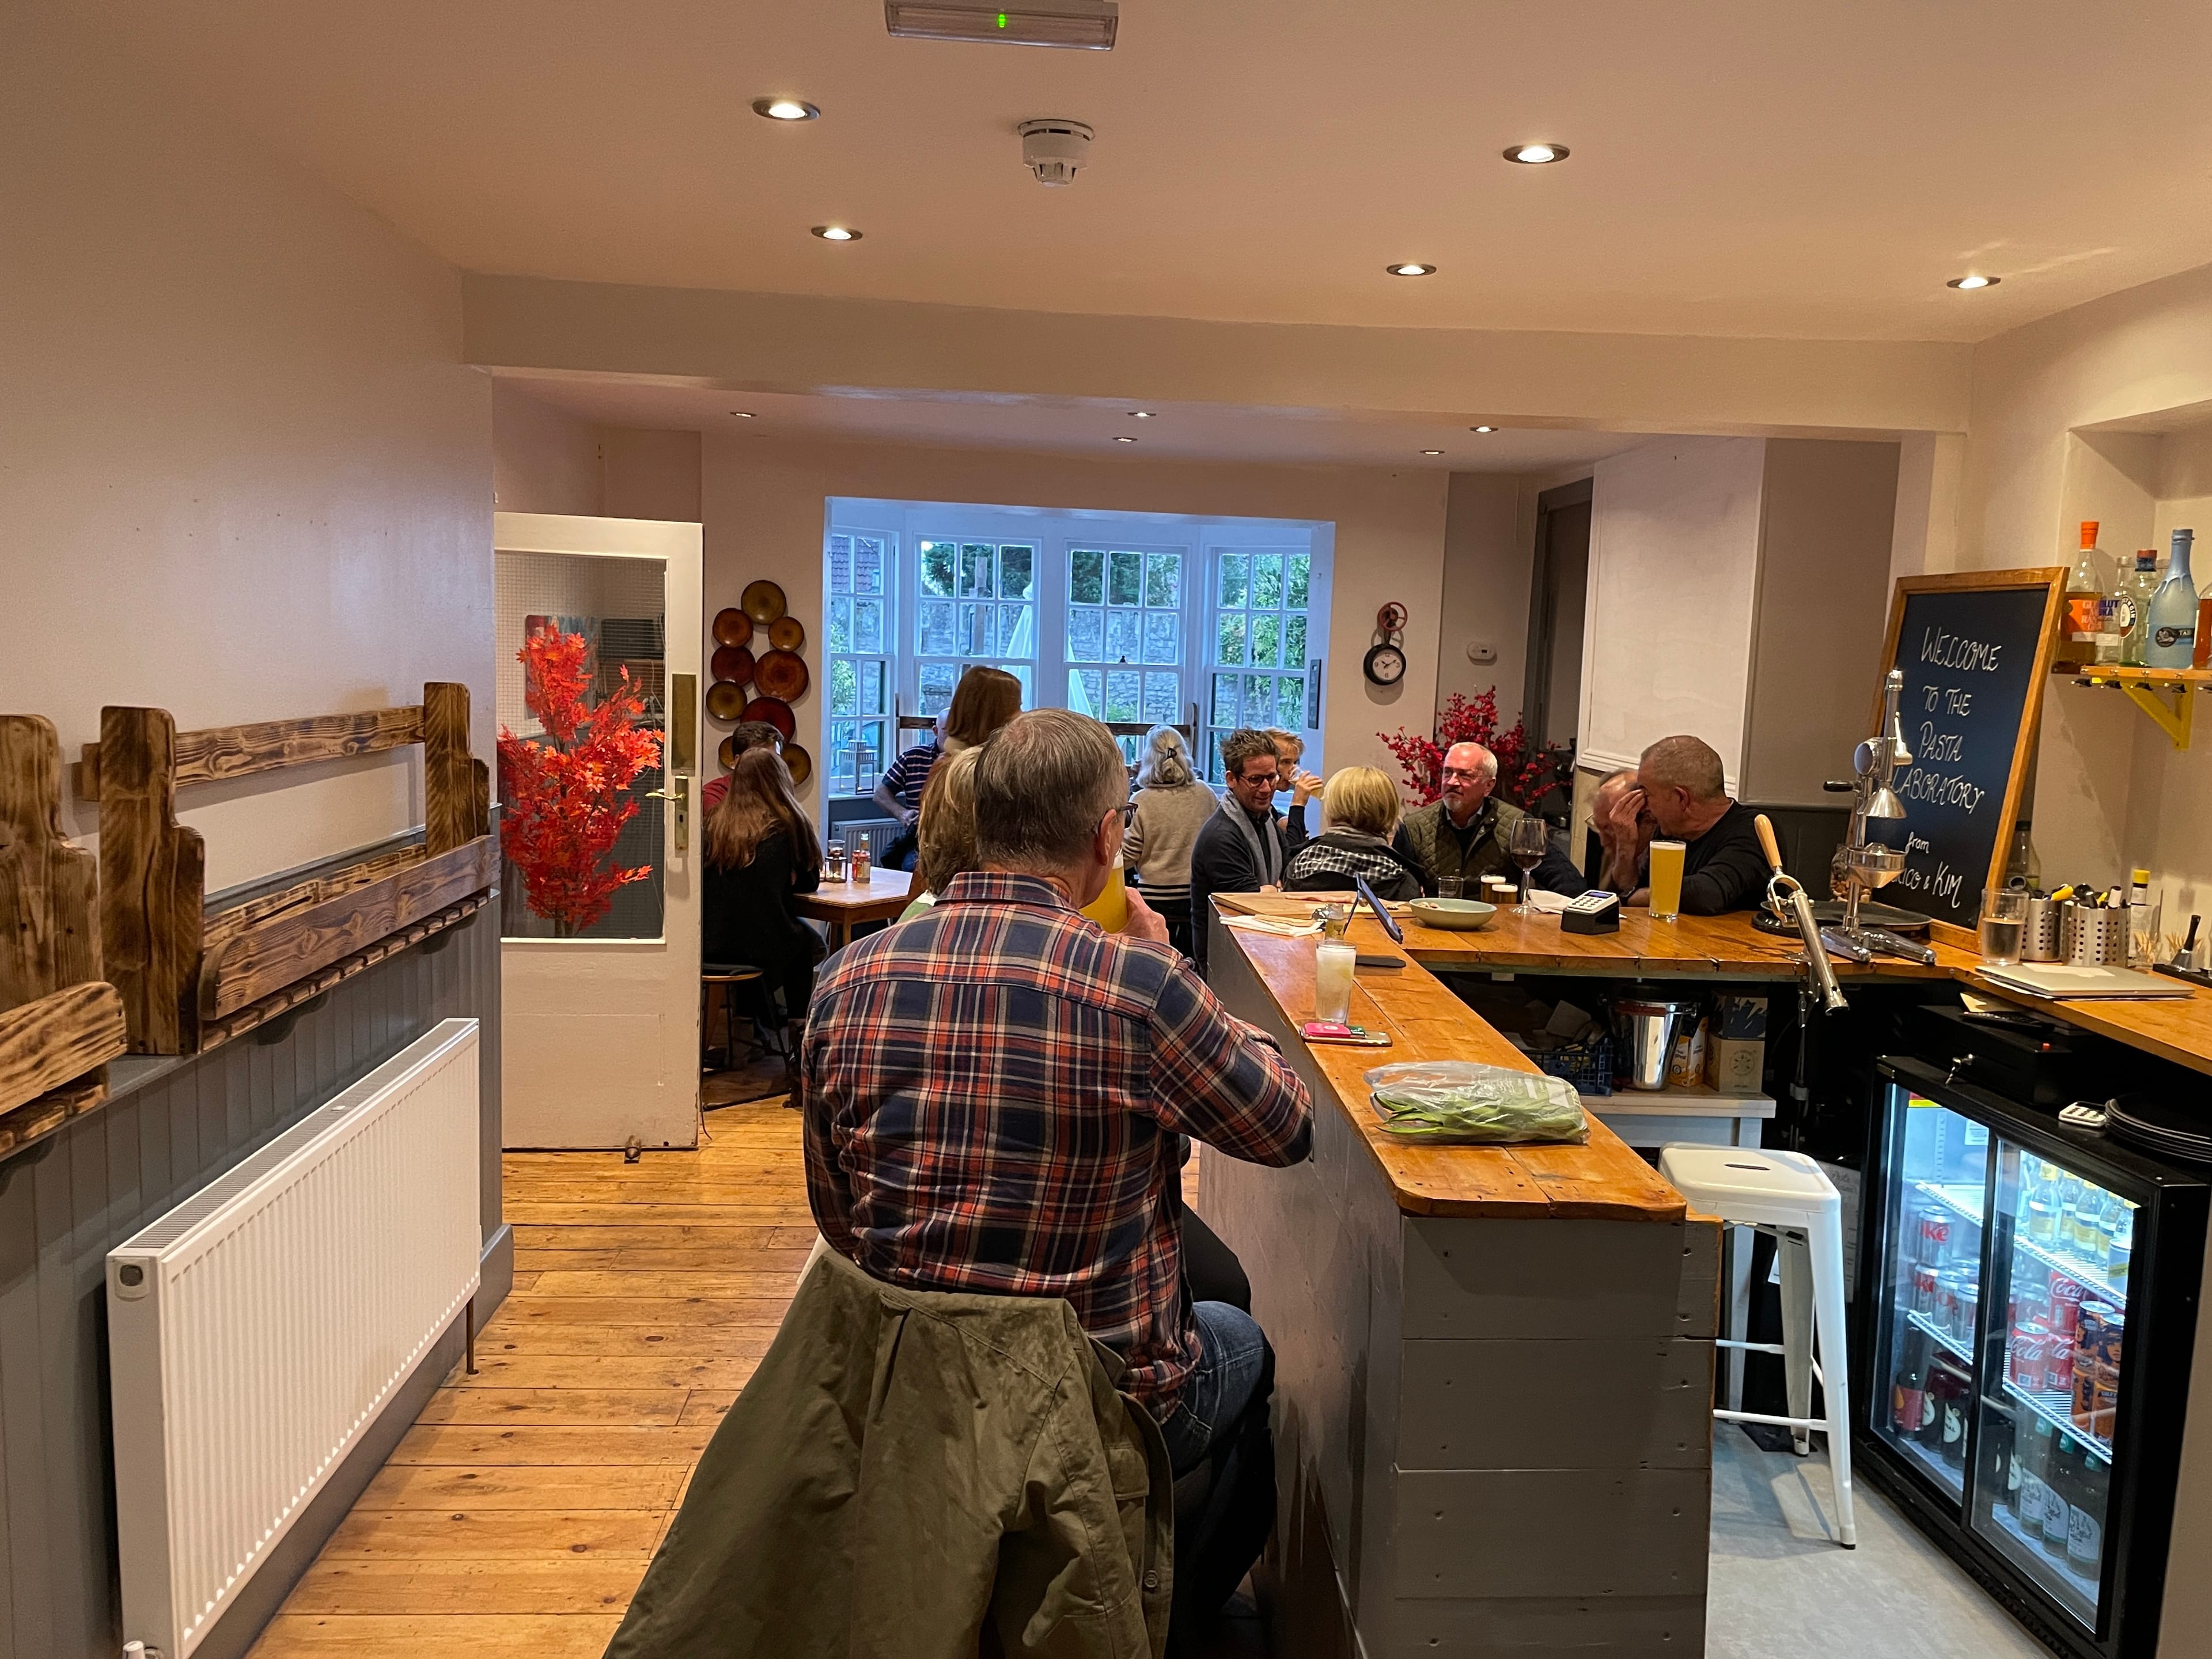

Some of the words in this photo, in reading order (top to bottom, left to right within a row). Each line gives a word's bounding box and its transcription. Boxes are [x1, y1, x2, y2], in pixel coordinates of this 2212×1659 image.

[1921, 627, 2002, 671] WELCOME
[1922, 685, 1939, 712] TO
[1945, 688, 1972, 716] THE
[1918, 721, 1963, 762] PASTA
[1891, 767, 1985, 815] LABORATORY
[1905, 831, 1929, 855] from
[1891, 868, 1922, 890] ICO
[1932, 861, 1963, 908] KIM
[2051, 1277, 2084, 1302] Coca
